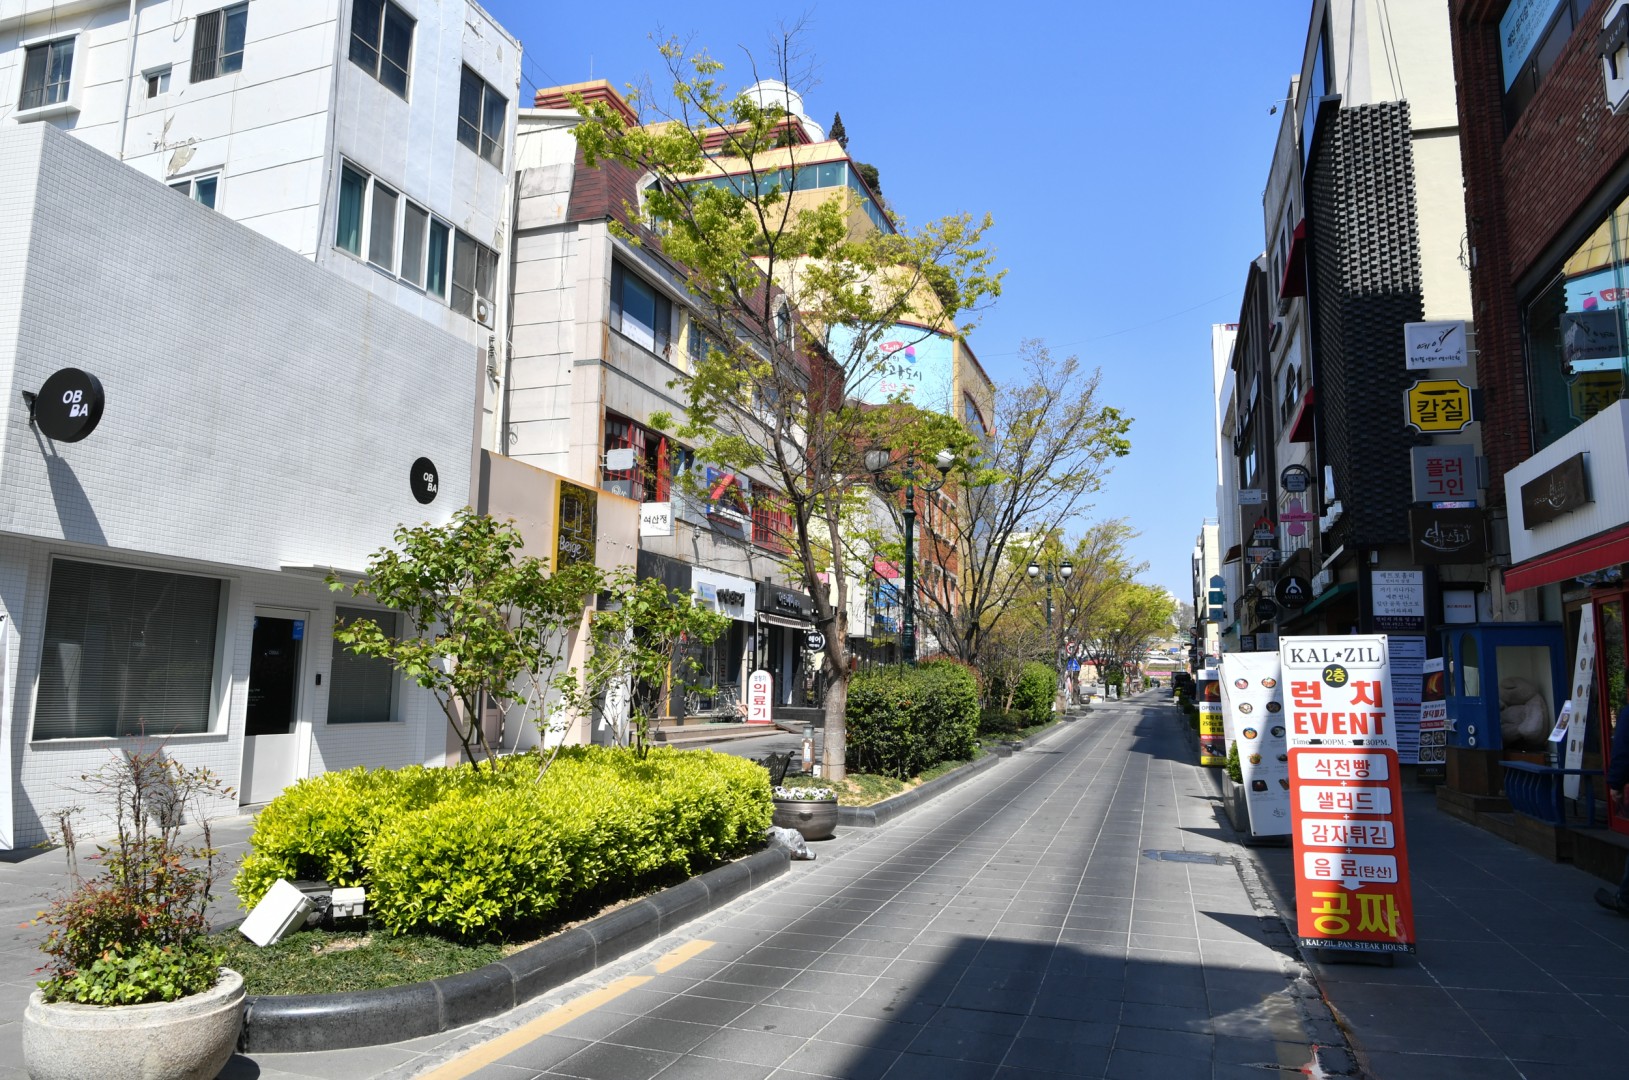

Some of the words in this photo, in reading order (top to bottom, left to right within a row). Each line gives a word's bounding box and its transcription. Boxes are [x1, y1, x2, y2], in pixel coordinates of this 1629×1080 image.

[880, 381, 897, 393] 울산
[62, 389, 83, 404] OB
[69, 403, 88, 418] BA
[1417, 398, 1464, 423] 칼질
[1426, 457, 1463, 477] 플러
[423, 472, 434, 483] OB
[1427, 477, 1465, 496] 그인
[427, 482, 437, 493] BA
[643, 514, 668, 525] 석산정
[559, 534, 582, 557] Beige
[808, 635, 821, 644] 헤어
[1325, 668, 1346, 683] 2층
[753, 683, 767, 718] 의료기
[1290, 680, 1322, 708] 런
[1349, 680, 1383, 708] 치
[1293, 712, 1386, 735] EVENT
[1315, 759, 1370, 778] 식전빵
[1317, 792, 1373, 810] 샐러드
[1312, 825, 1387, 845] 감자튀김
[1311, 891, 1400, 937] 공짜
[1355, 942, 1380, 950] STEAK
[1382, 944, 1409, 952] HOUSE
